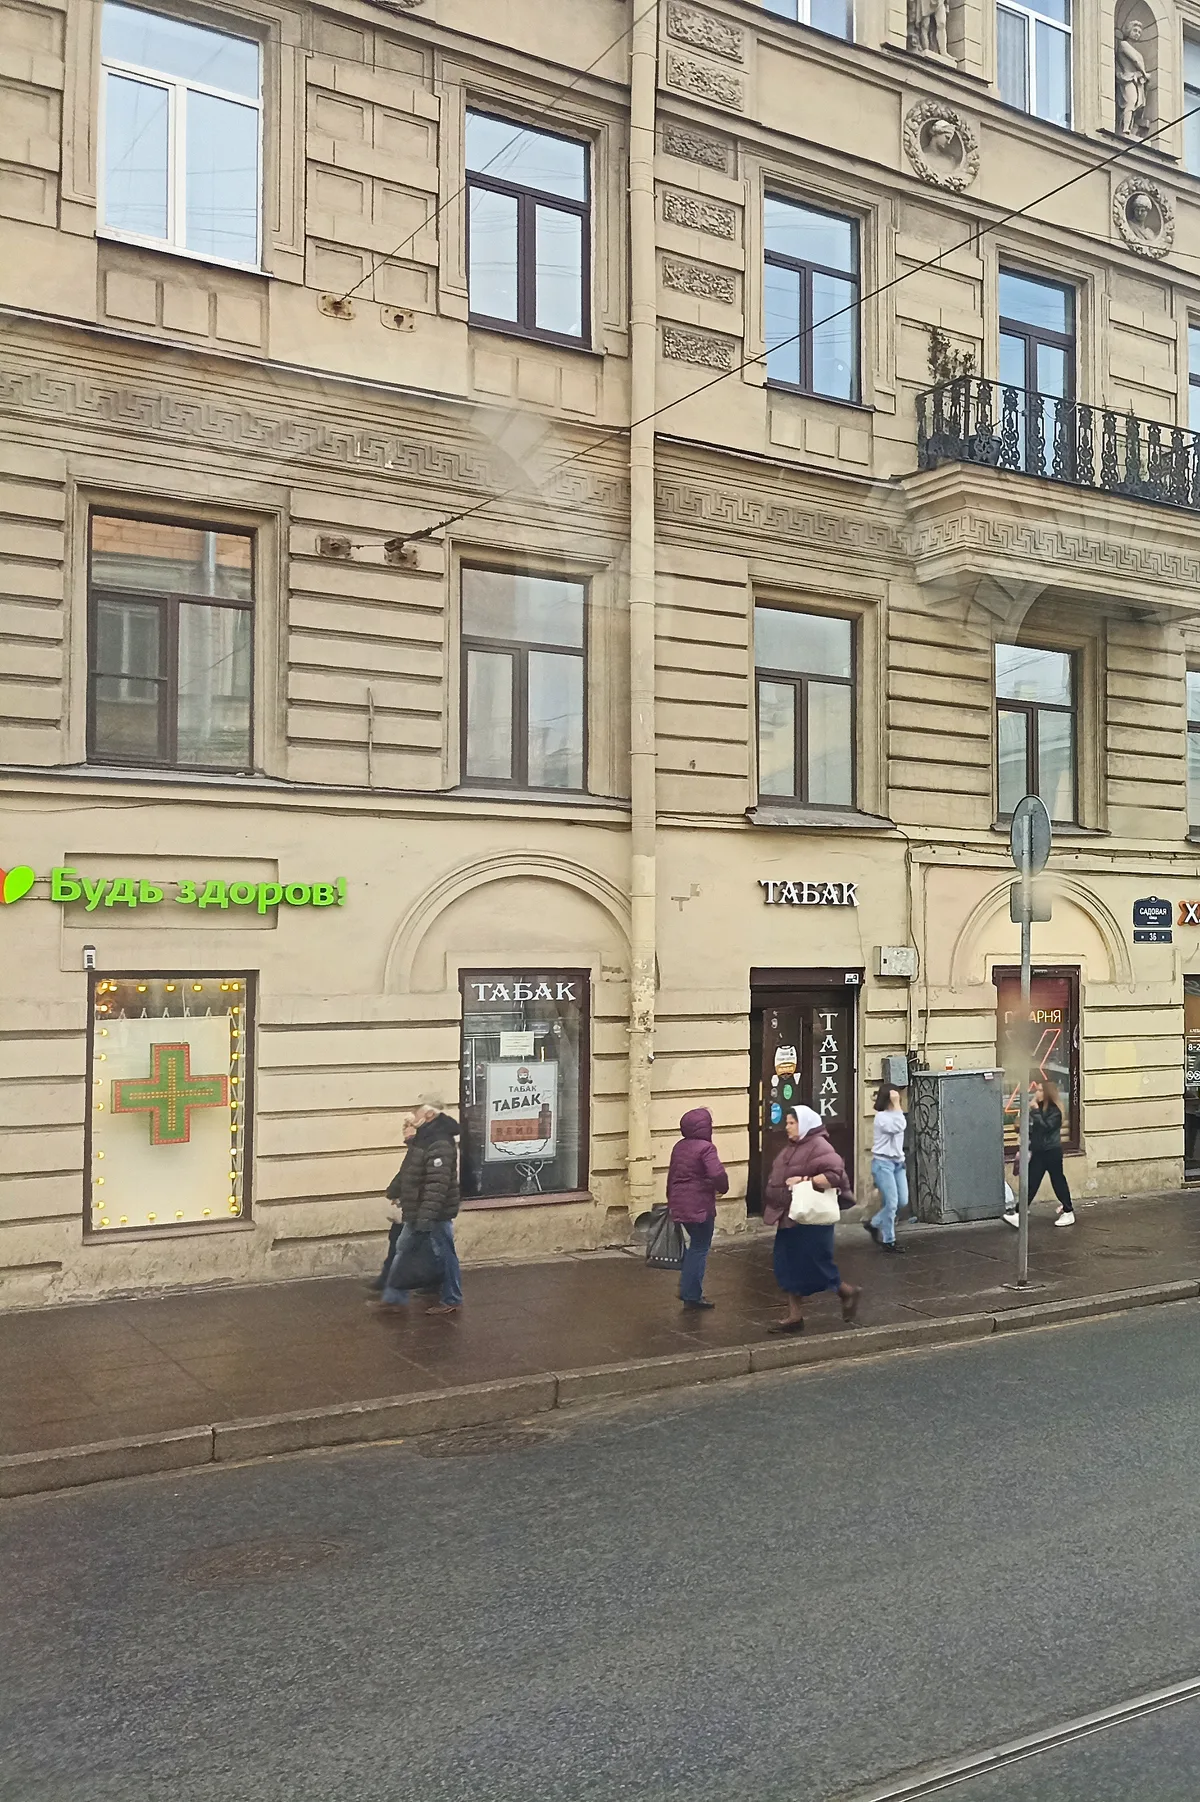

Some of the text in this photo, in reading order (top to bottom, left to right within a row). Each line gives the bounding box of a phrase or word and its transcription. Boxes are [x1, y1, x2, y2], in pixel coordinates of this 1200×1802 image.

[51, 866, 349, 915] Будь здоров!
[759, 879, 861, 907] ТАБАК
[1139, 907, 1167, 916] САДОВАЯ
[1149, 932, 1157, 941] 36
[470, 982, 577, 1002] ТАБАК
[1004, 1010, 1062, 1024] ПАРНЯ
[818, 1013, 839, 1117] ТАБАК
[508, 1085, 537, 1093] ТАБАК
[492, 1093, 541, 1112] ТАБАК
